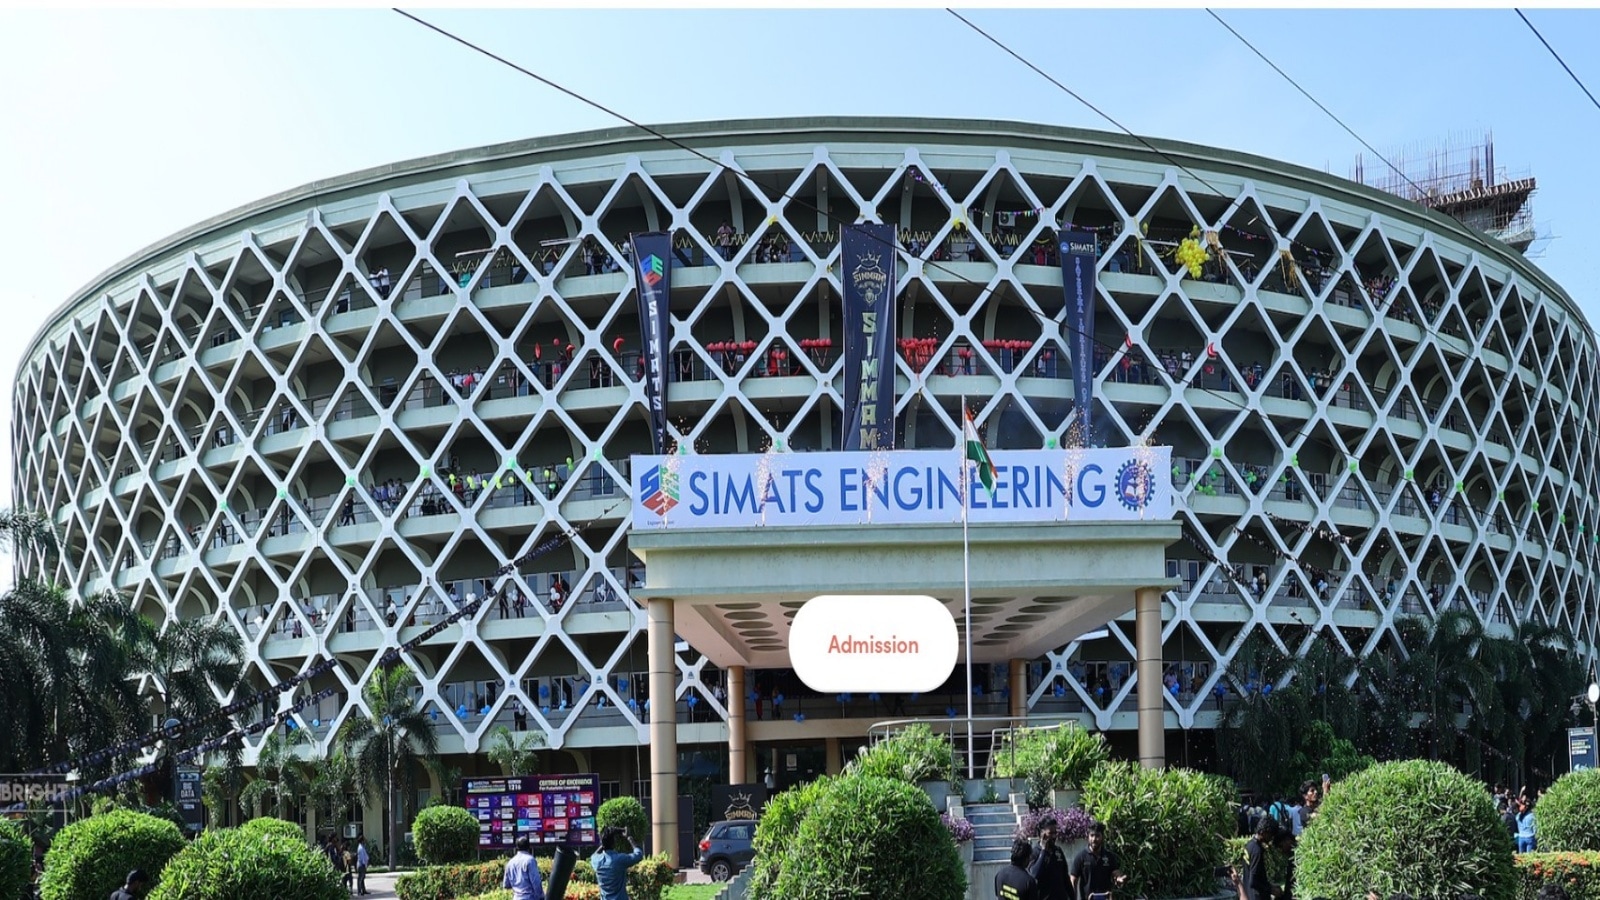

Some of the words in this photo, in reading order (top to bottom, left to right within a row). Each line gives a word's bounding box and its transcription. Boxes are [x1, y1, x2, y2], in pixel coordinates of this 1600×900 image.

[1070, 242, 1094, 253] SIMATS
[648, 300, 662, 411] SIMATS
[860, 312, 878, 450] SIMMAM
[689, 468, 824, 516] SIMATS
[840, 463, 1106, 511] ENGINEERING
[180, 790, 195, 798] DATA
